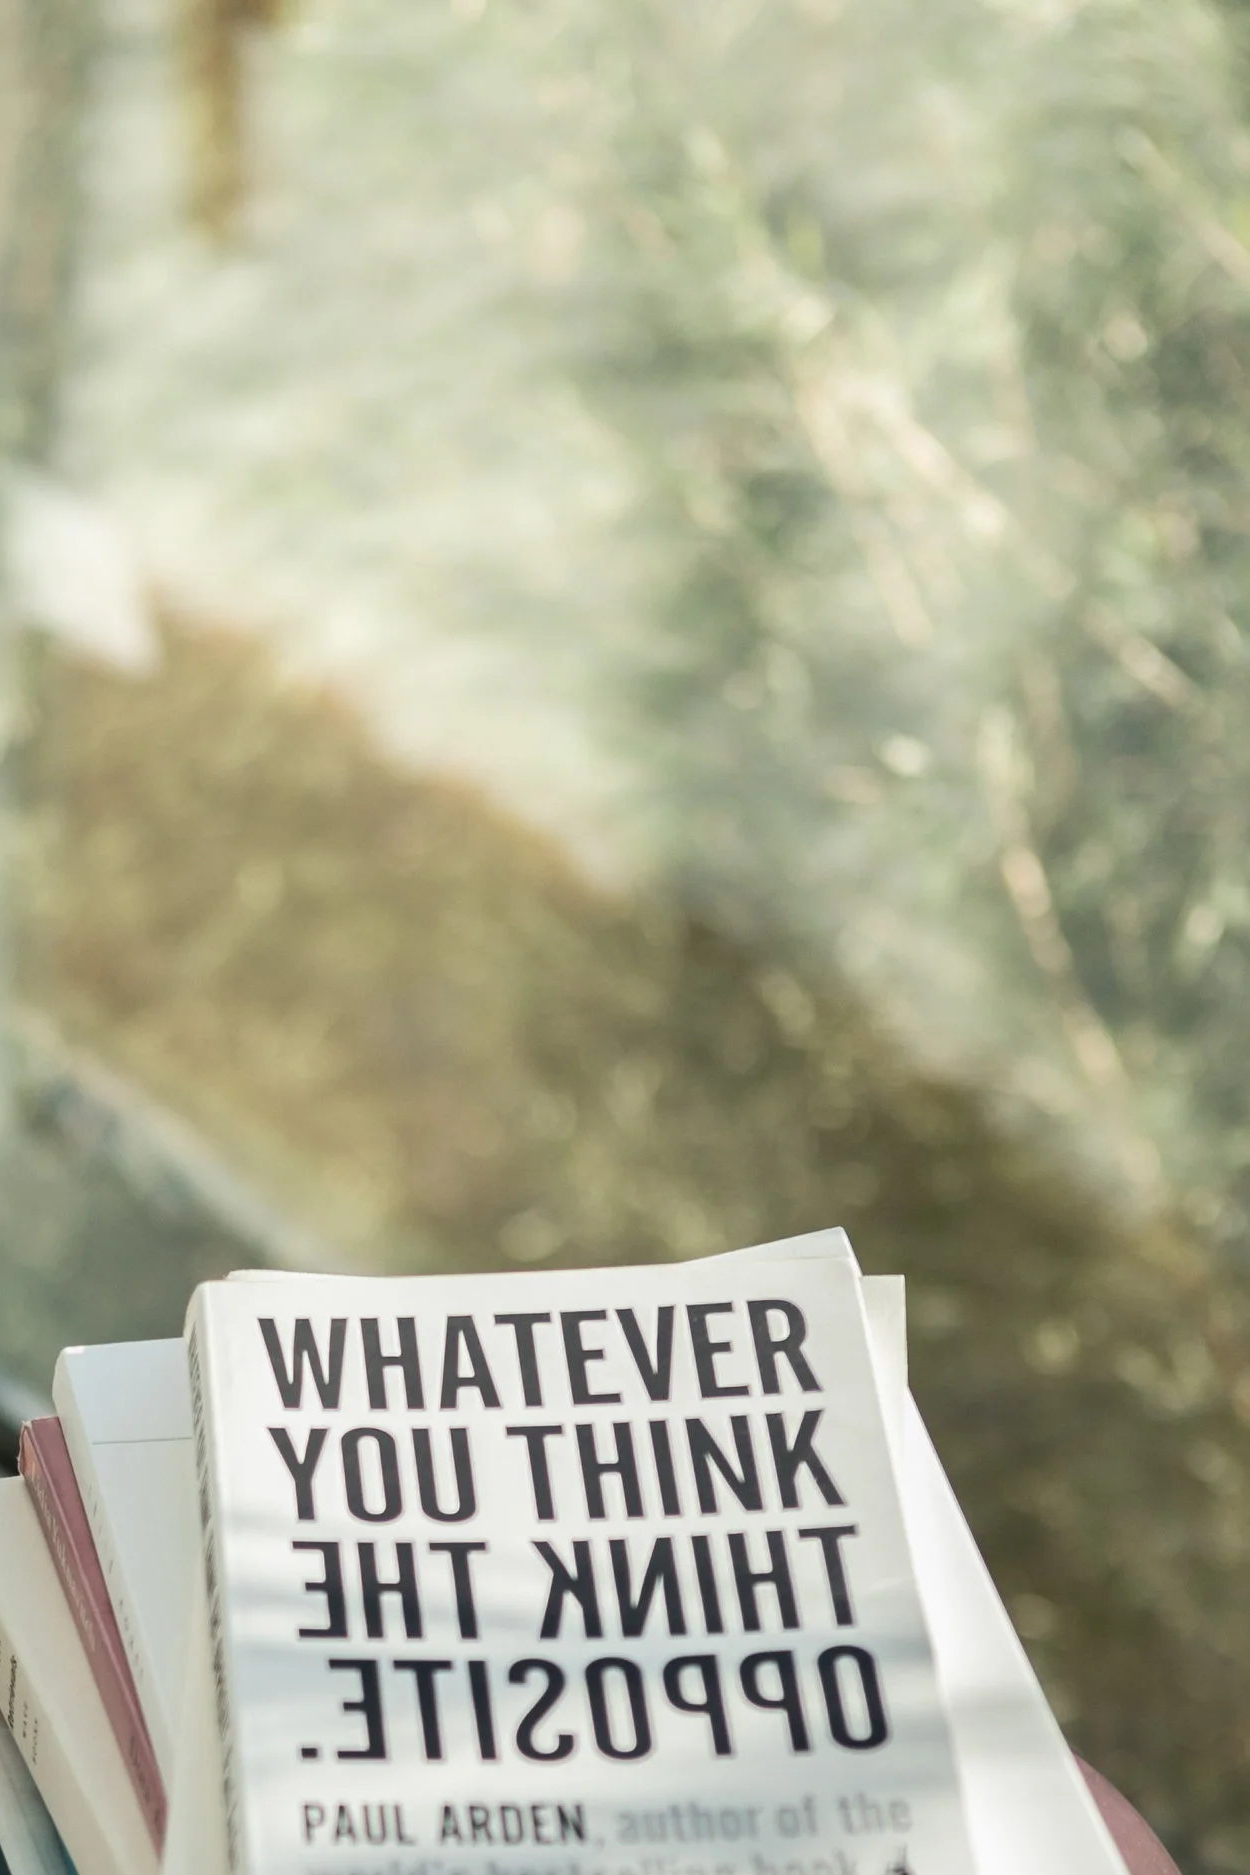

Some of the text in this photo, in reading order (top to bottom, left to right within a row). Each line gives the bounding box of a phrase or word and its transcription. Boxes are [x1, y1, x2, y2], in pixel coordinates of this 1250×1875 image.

[257, 1297, 823, 1411] WHATEVER
[268, 1408, 847, 1523] YOU THINK
[301, 1802, 416, 1847] PAUL
[616, 1800, 764, 1845] author
[776, 1794, 818, 1839] of
[839, 1791, 914, 1836] the
